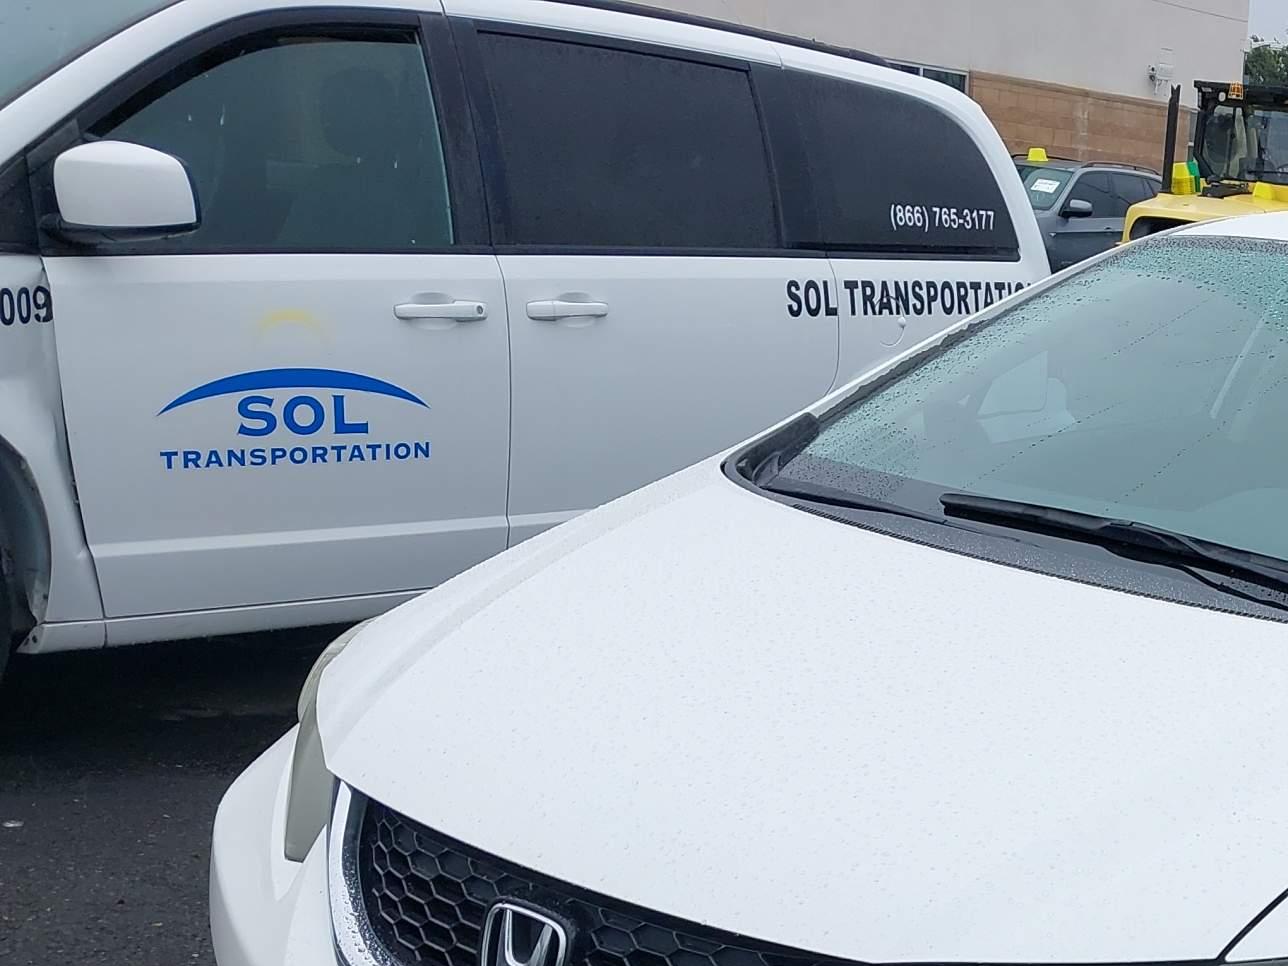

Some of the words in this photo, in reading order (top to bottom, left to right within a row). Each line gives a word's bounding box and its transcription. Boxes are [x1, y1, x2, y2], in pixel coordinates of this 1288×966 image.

[890, 204, 929, 232] (866)
[932, 207, 995, 231] 765-3177
[0, 285, 54, 326] 009
[786, 279, 838, 317] SOL
[844, 280, 1031, 317] TRANSPORTAT
[237, 395, 369, 436] SOL
[159, 441, 430, 470] TRANSPORTATION
